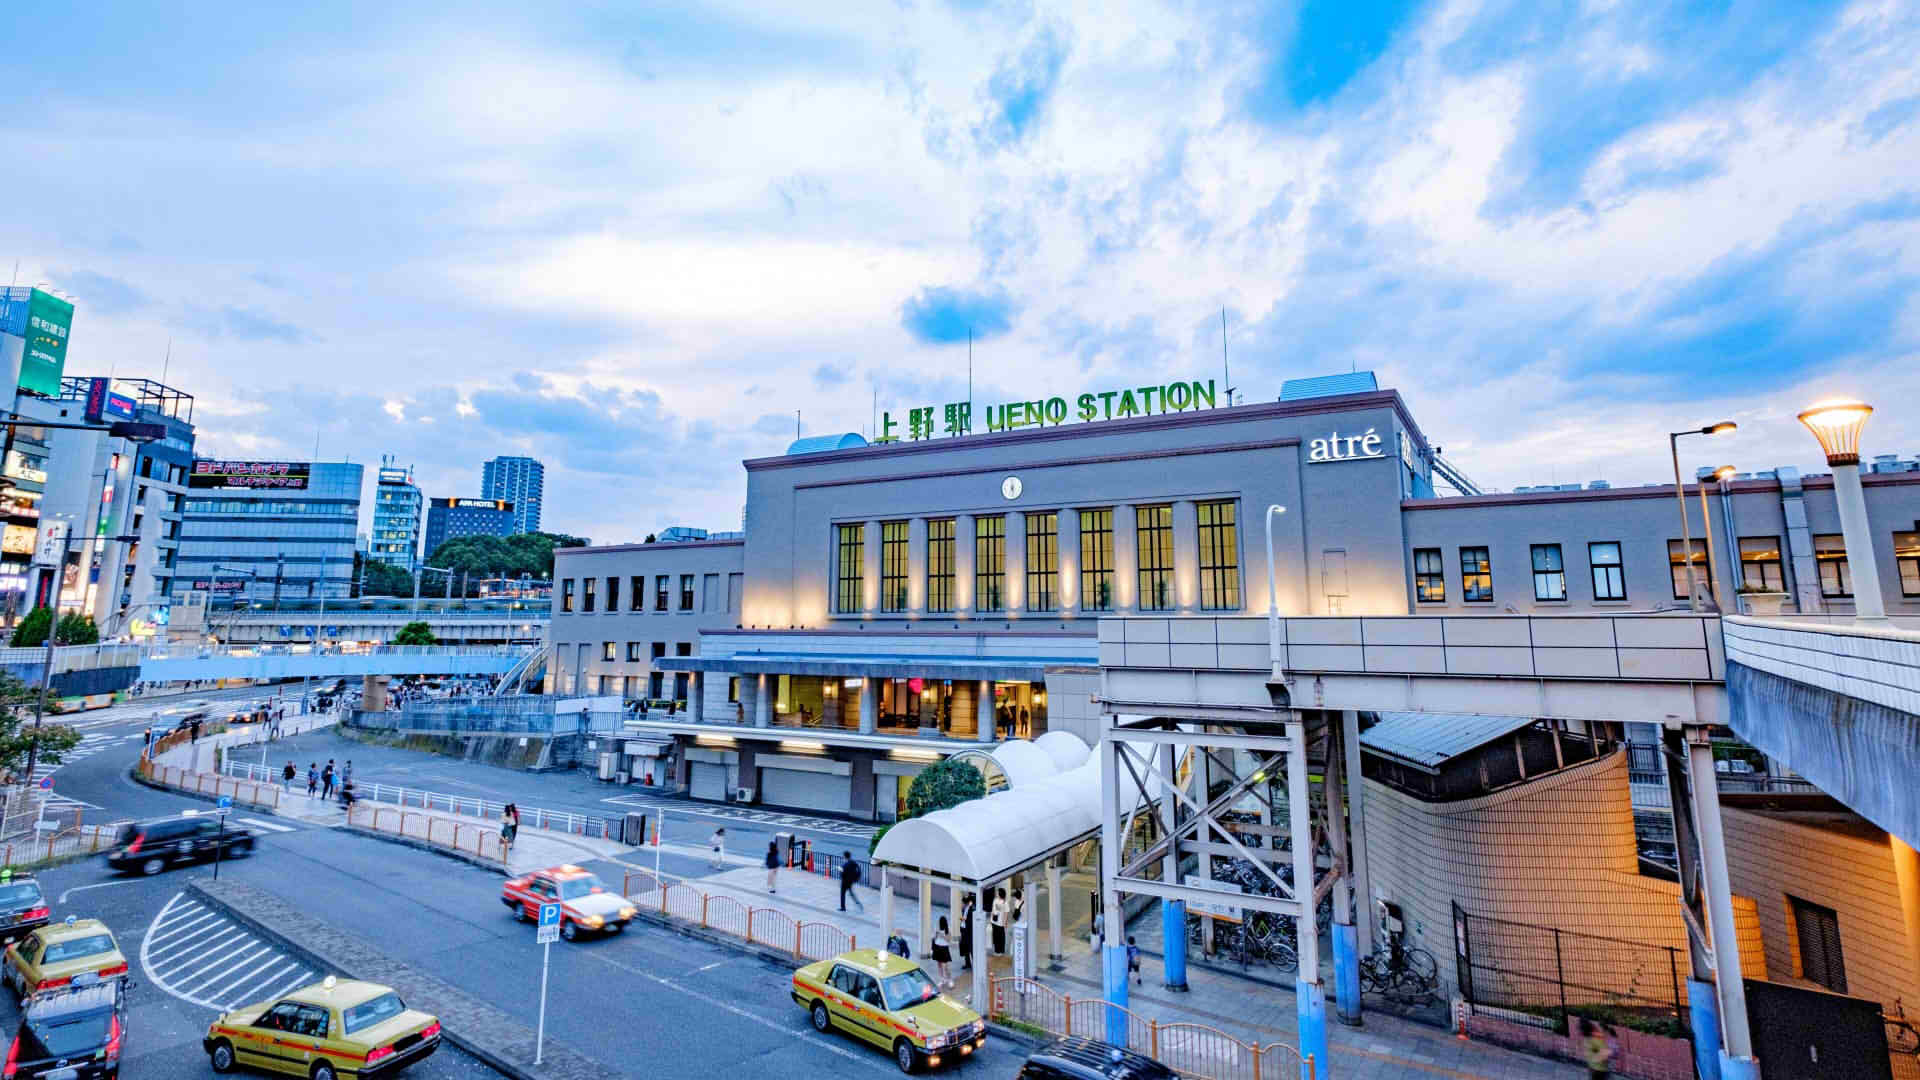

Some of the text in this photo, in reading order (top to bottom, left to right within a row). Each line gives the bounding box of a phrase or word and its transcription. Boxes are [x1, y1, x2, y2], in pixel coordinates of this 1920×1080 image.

[986, 379, 1215, 431] UENO STATION
[876, 402, 971, 441] 上野駅
[1309, 428, 1382, 460] atré
[195, 462, 290, 475] ヨドバシカメラ
[473, 500, 496, 508] HOTEL
[544, 906, 557, 924] P
